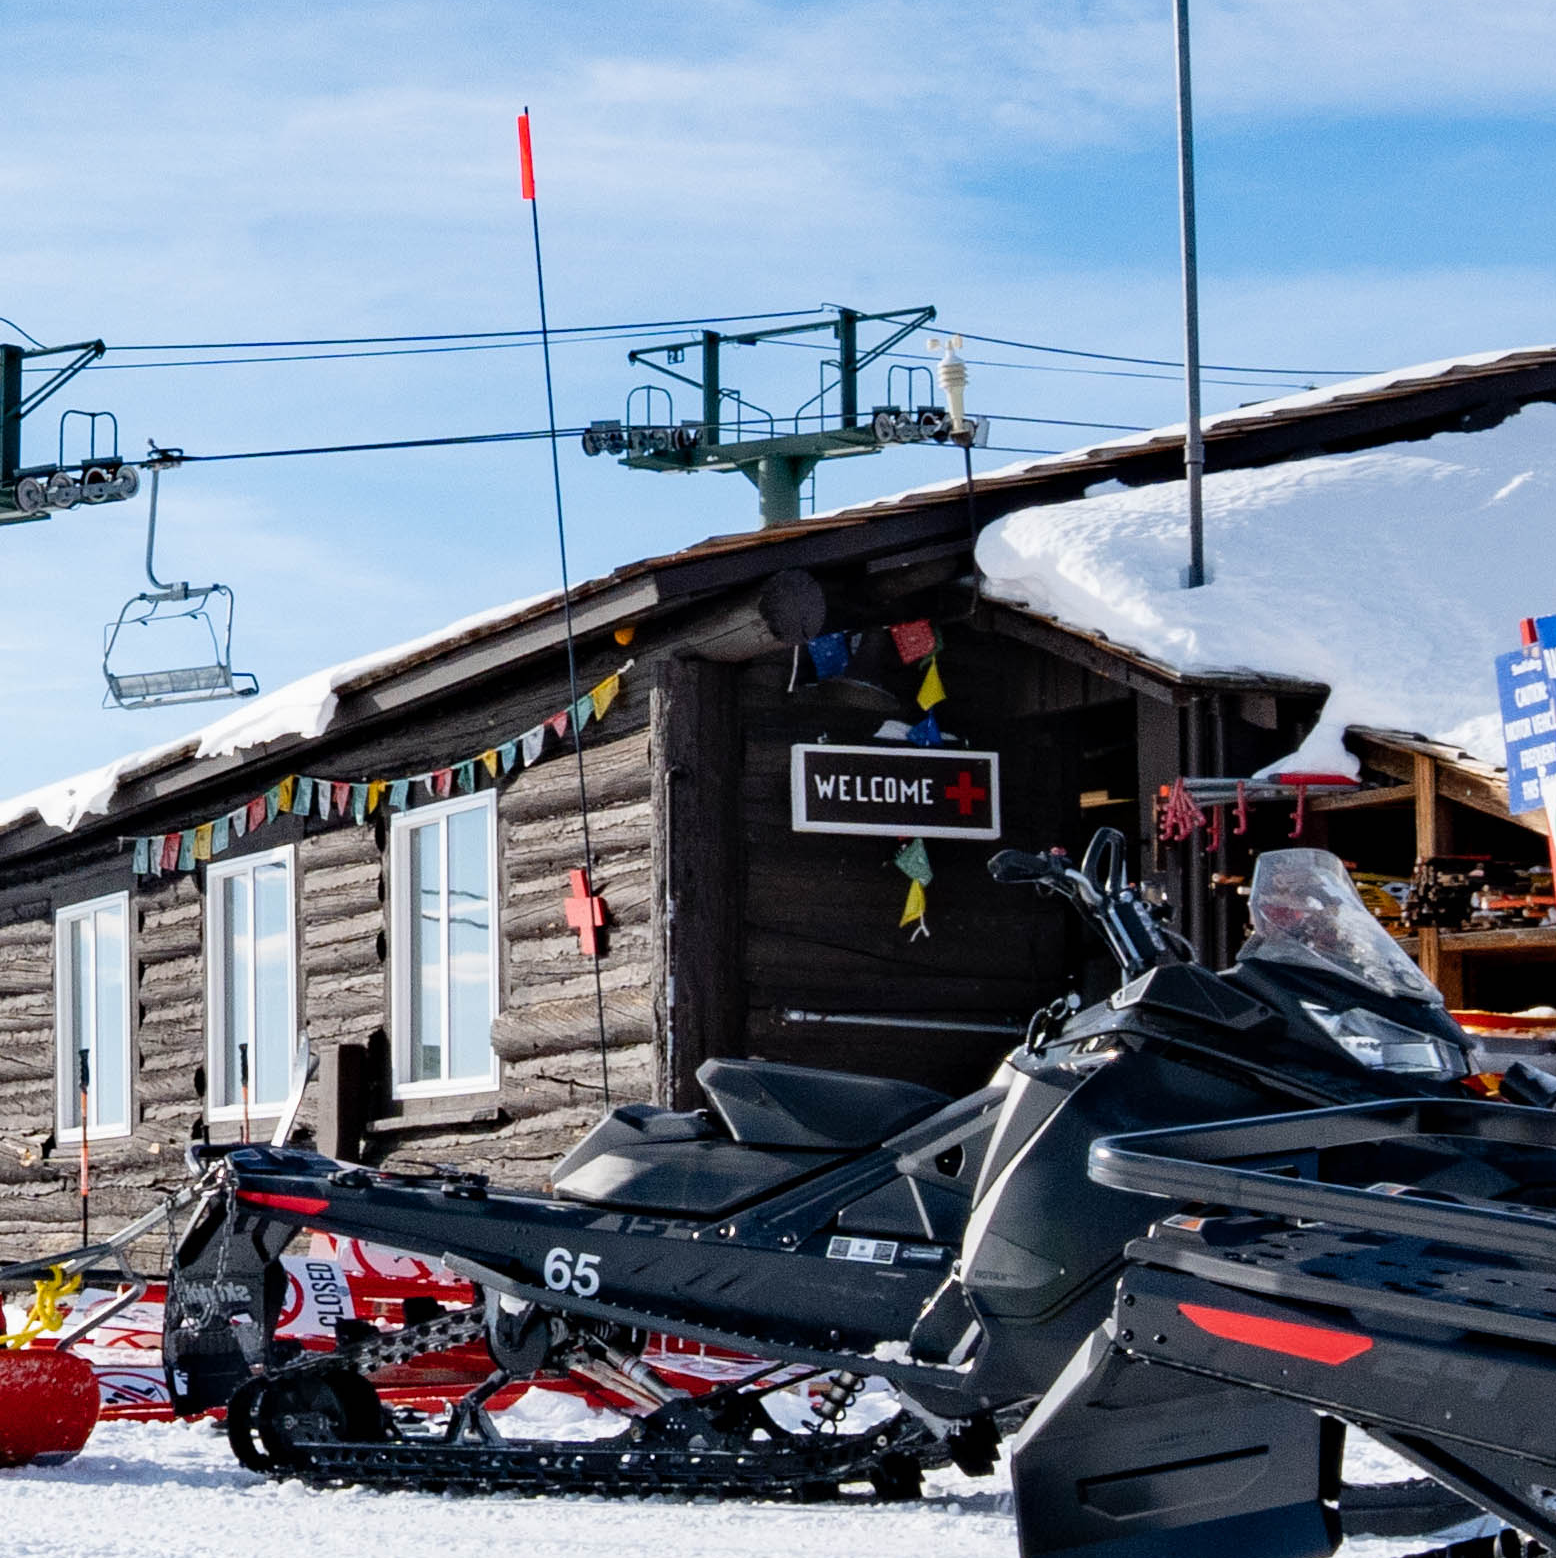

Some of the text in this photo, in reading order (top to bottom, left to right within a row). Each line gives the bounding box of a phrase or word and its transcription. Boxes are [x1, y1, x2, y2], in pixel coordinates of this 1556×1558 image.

[813, 773, 934, 805] WELCOME
[305, 1262, 344, 1328] CLOSED
[544, 1247, 602, 1297] 65
